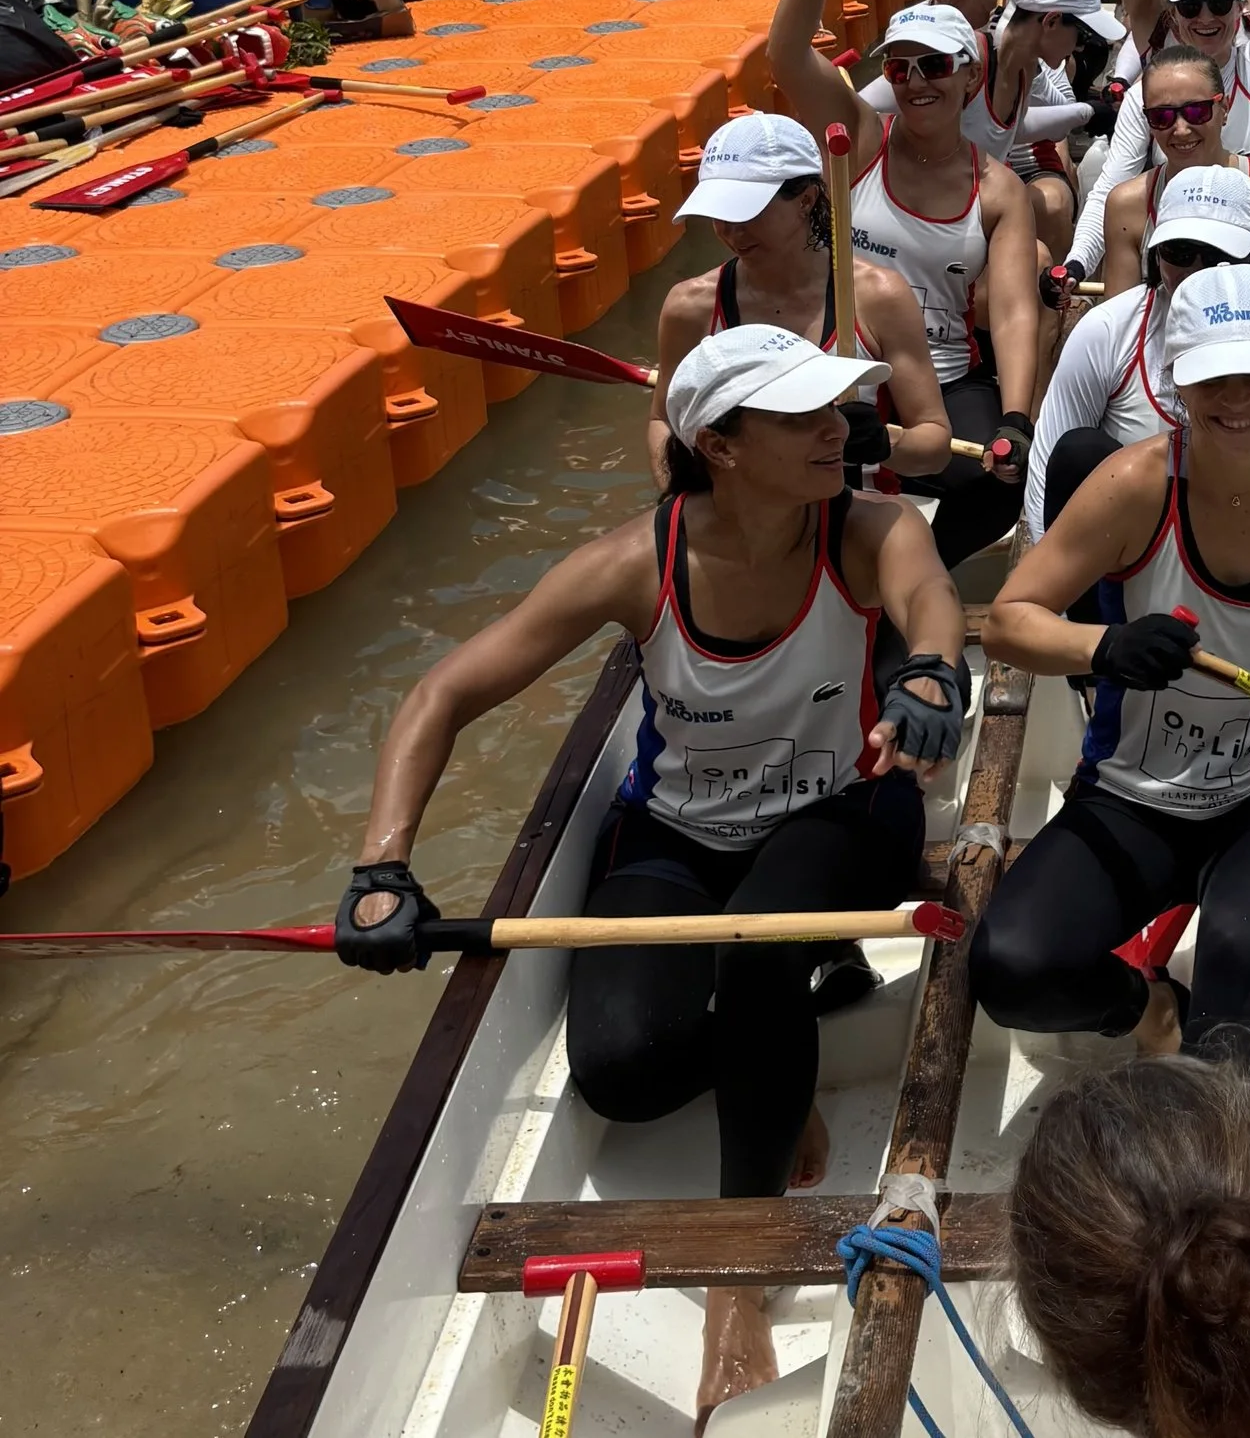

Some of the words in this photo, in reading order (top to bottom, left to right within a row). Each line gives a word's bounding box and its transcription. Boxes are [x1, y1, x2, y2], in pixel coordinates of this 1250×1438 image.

[84, 166, 154, 198] STANLEY
[1183, 187, 1203, 196] TV5
[1187, 195, 1228, 207] MONDE
[1202, 302, 1230, 317] TV5
[444, 328, 567, 367] STANLEY
[760, 333, 785, 352] TV5
[658, 690, 687, 711] TV5
[665, 706, 735, 723] MONDE
[1164, 710, 1204, 739] On
